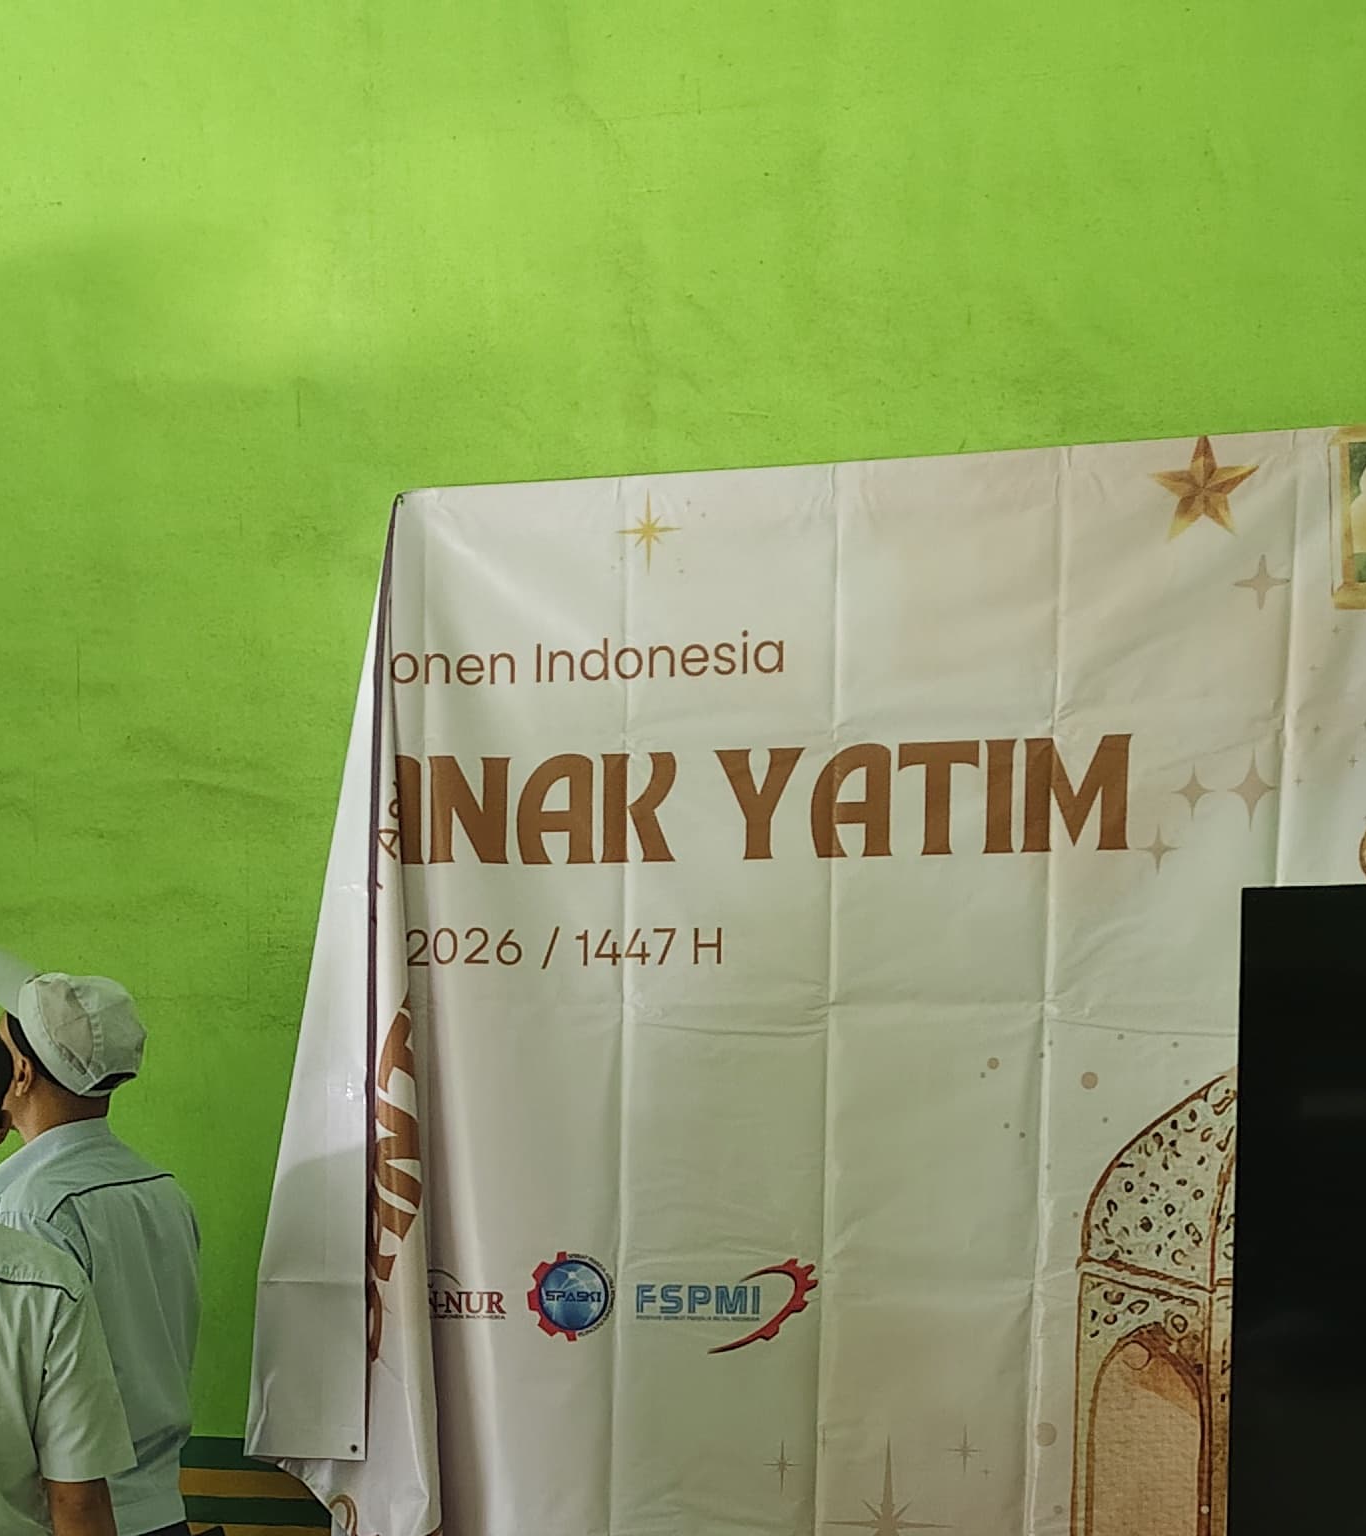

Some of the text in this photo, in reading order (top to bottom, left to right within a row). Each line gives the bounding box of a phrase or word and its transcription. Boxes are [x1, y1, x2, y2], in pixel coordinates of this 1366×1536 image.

[391, 629, 785, 686] onen Indonesia
[713, 733, 1133, 861] YATIM
[406, 926, 722, 970] 2026 / 1447 H
[636, 1284, 761, 1315] FSPMI
